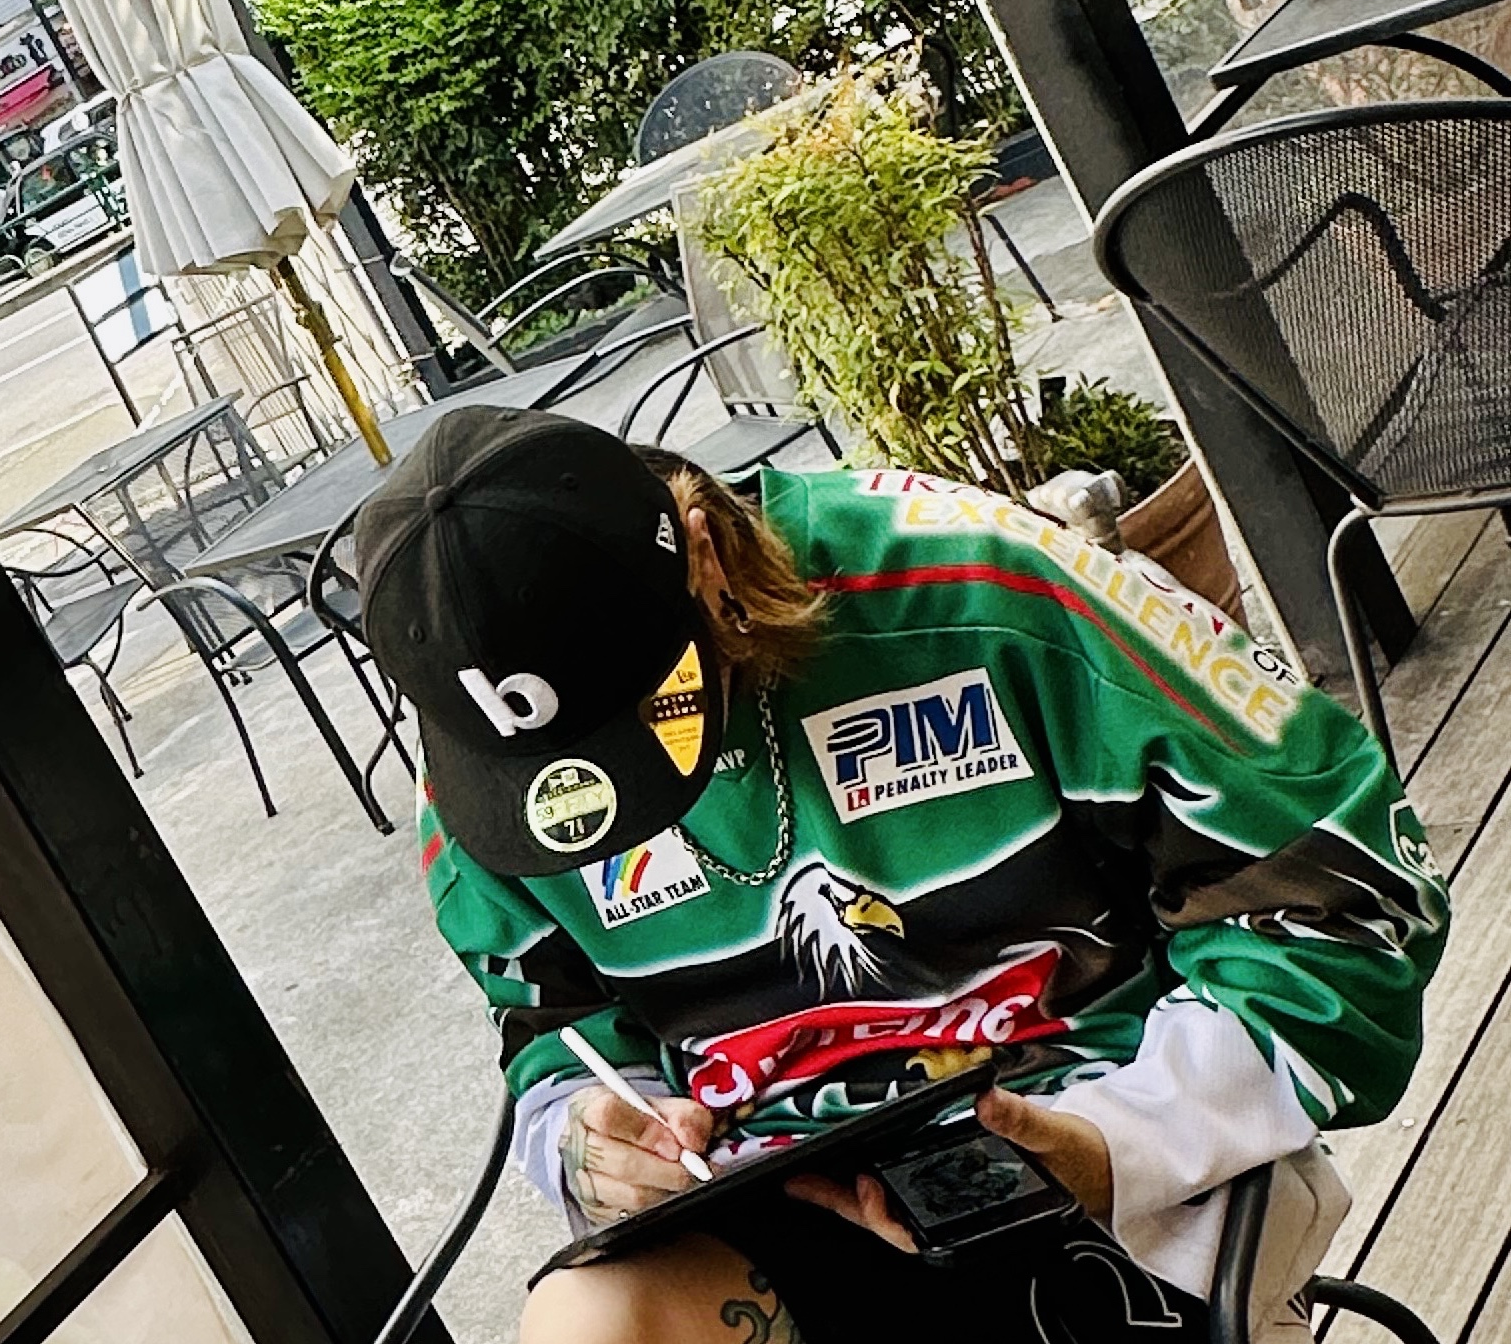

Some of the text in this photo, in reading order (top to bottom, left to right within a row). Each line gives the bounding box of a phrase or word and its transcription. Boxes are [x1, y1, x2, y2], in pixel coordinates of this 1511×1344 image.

[904, 496, 1289, 738] EXCELLENCE
[1252, 649, 1299, 688] OF
[825, 680, 1000, 787] PIM
[874, 767, 950, 803] PENALTY
[954, 752, 1020, 786] LEADER
[605, 874, 706, 925] ALL-STAR TEAM
